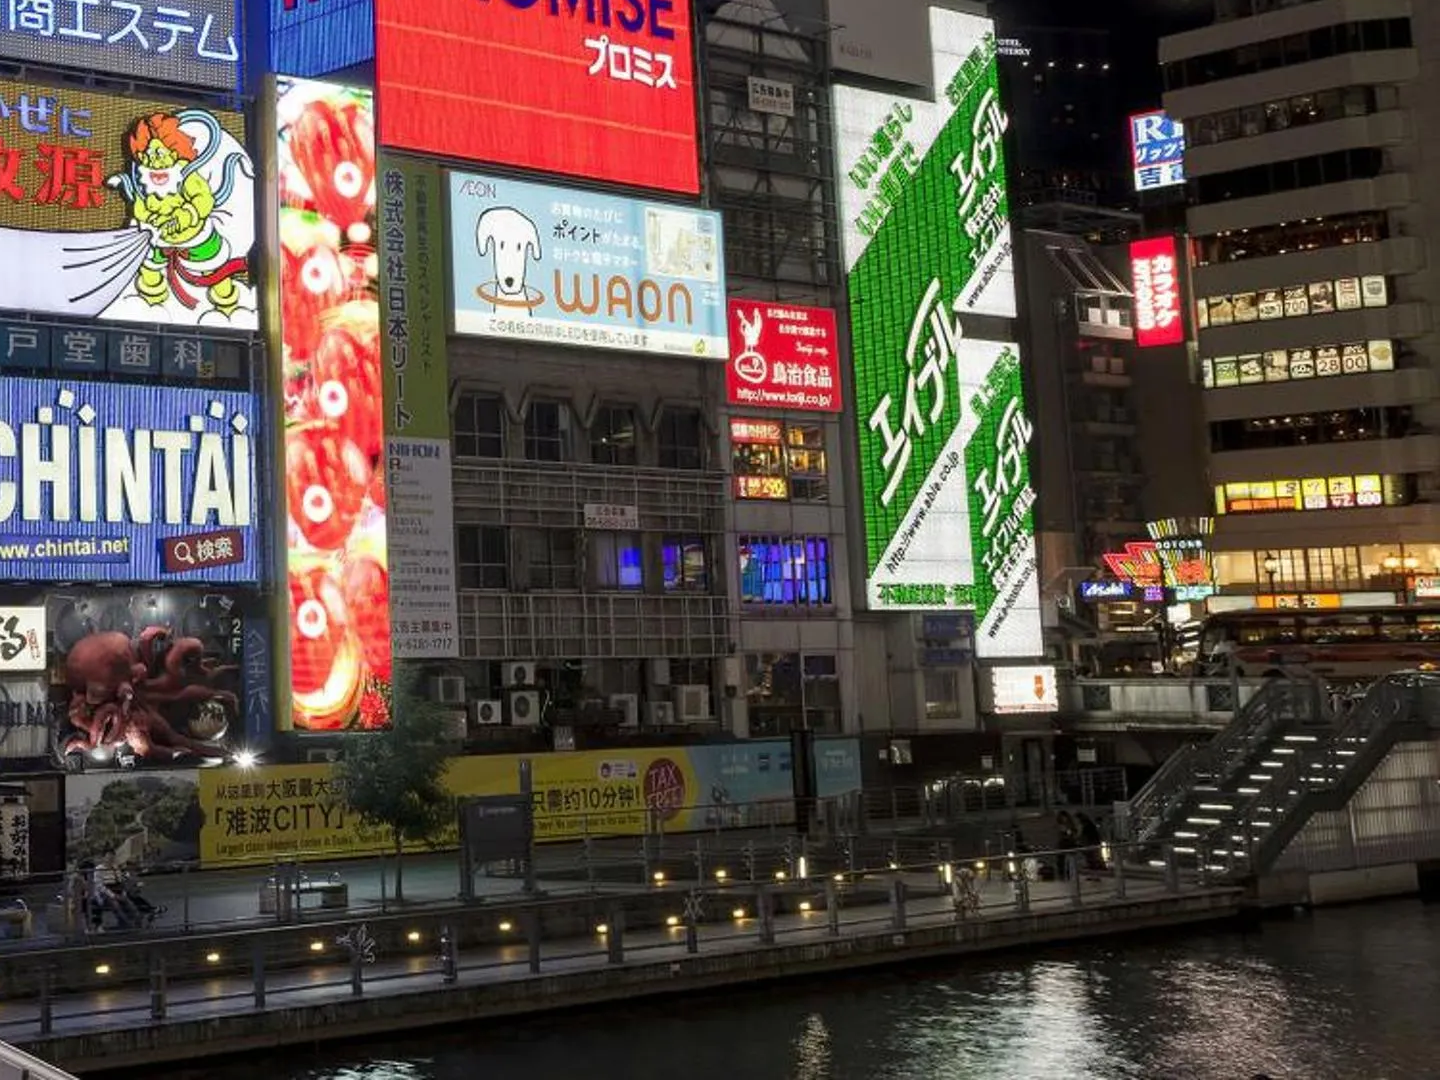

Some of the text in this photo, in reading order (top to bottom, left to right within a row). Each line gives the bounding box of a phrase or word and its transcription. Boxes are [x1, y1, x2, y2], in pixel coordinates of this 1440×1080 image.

[584, 34, 678, 89] プロミス
[384, 169, 413, 428] 株式会社日本リート
[554, 269, 692, 325] WAON
[1152, 254, 1180, 328] カラオケ
[868, 278, 963, 506] エイブル
